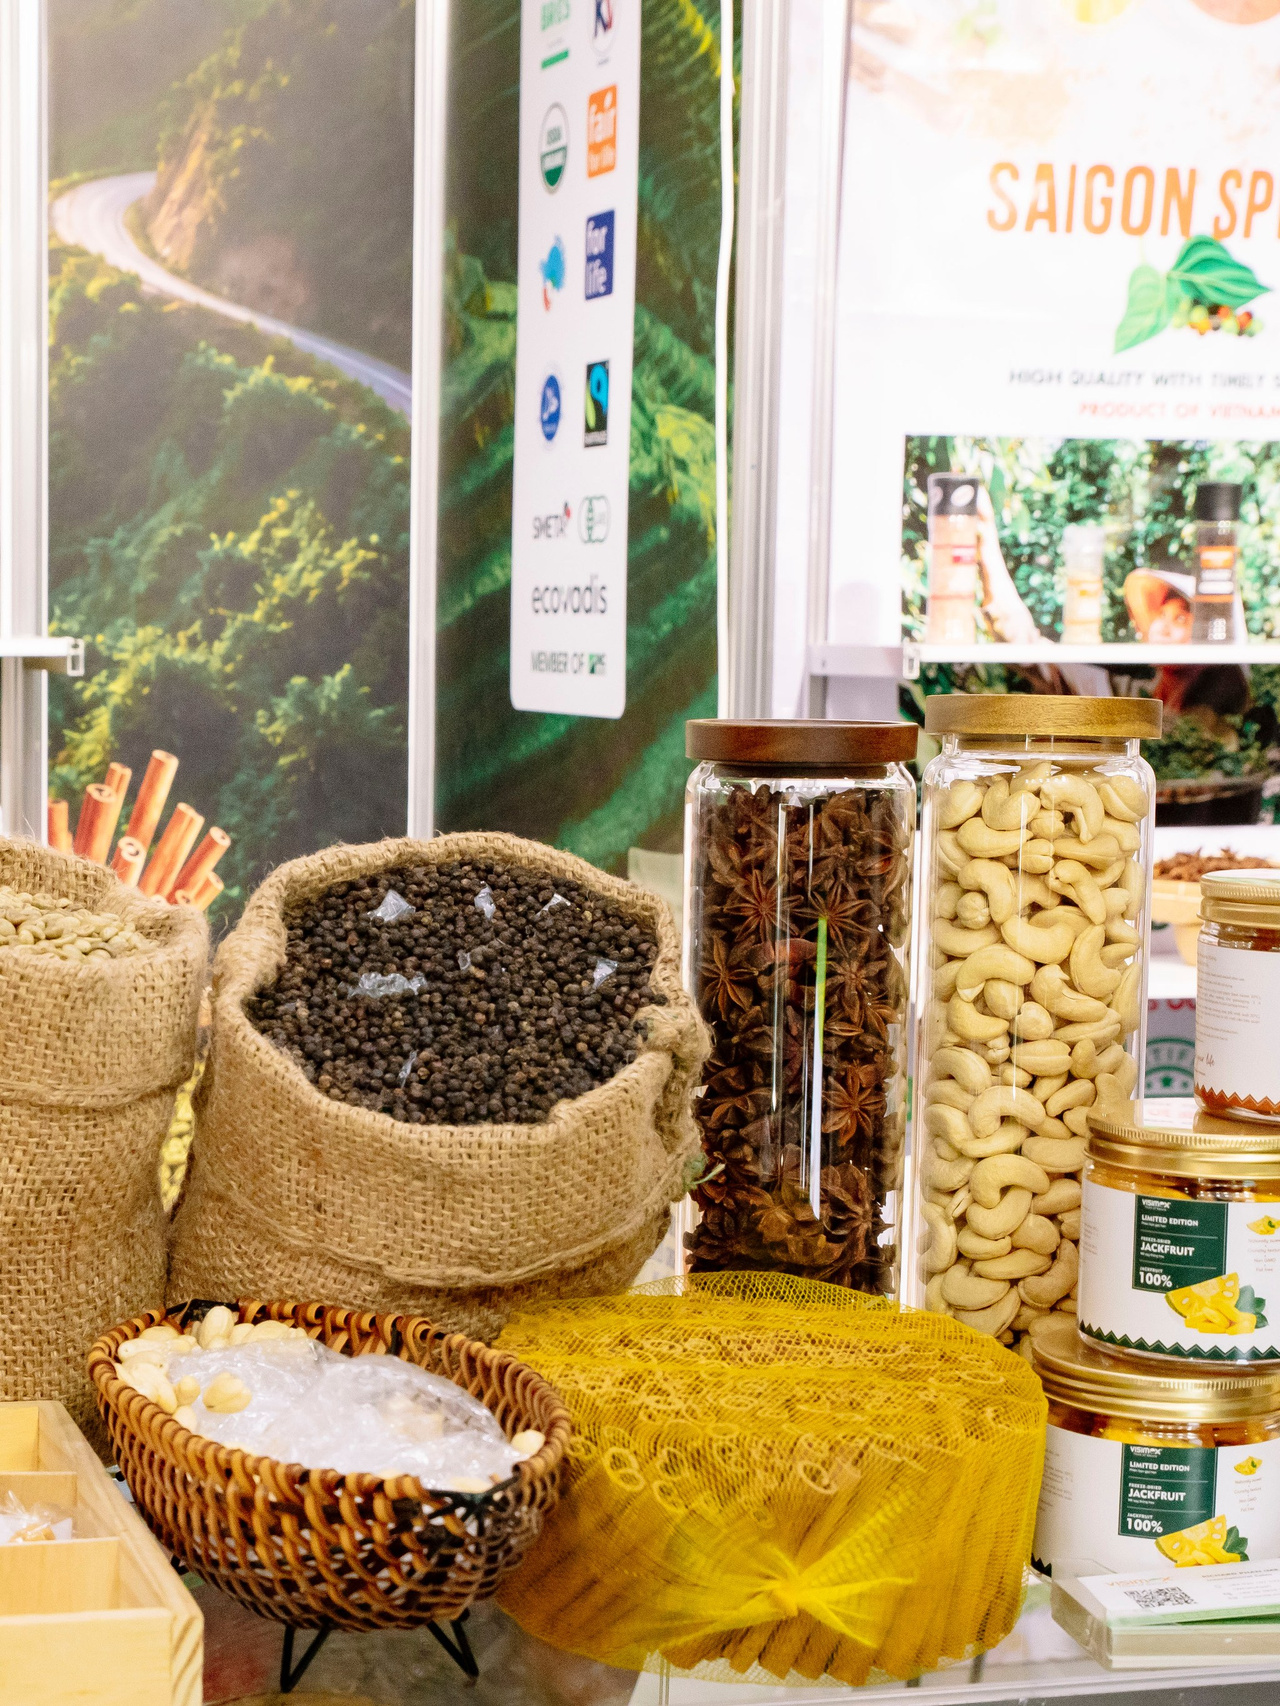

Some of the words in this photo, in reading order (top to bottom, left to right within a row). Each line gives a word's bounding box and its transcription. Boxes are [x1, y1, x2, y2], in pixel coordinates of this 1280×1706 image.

[986, 162, 1197, 239] SAIGON
[1212, 168, 1280, 241] SP
[1009, 369, 1063, 385] HIGH
[1070, 370, 1144, 386] QUALITY
[1150, 371, 1202, 387] WITH
[1078, 402, 1166, 418] PRODUCT
[1174, 402, 1199, 419] OF
[571, 651, 584, 674] OF
[1141, 1214, 1168, 1224] LIMITED
[1169, 1217, 1199, 1227] EDITION
[1140, 1241, 1195, 1257] JACKFRUIT
[1139, 1271, 1173, 1288] 100%
[1129, 1461, 1159, 1470] LIMITED
[1160, 1463, 1190, 1472] EDITION
[1128, 1488, 1187, 1502] JACKFRUIT
[1126, 1518, 1164, 1534] 100%
